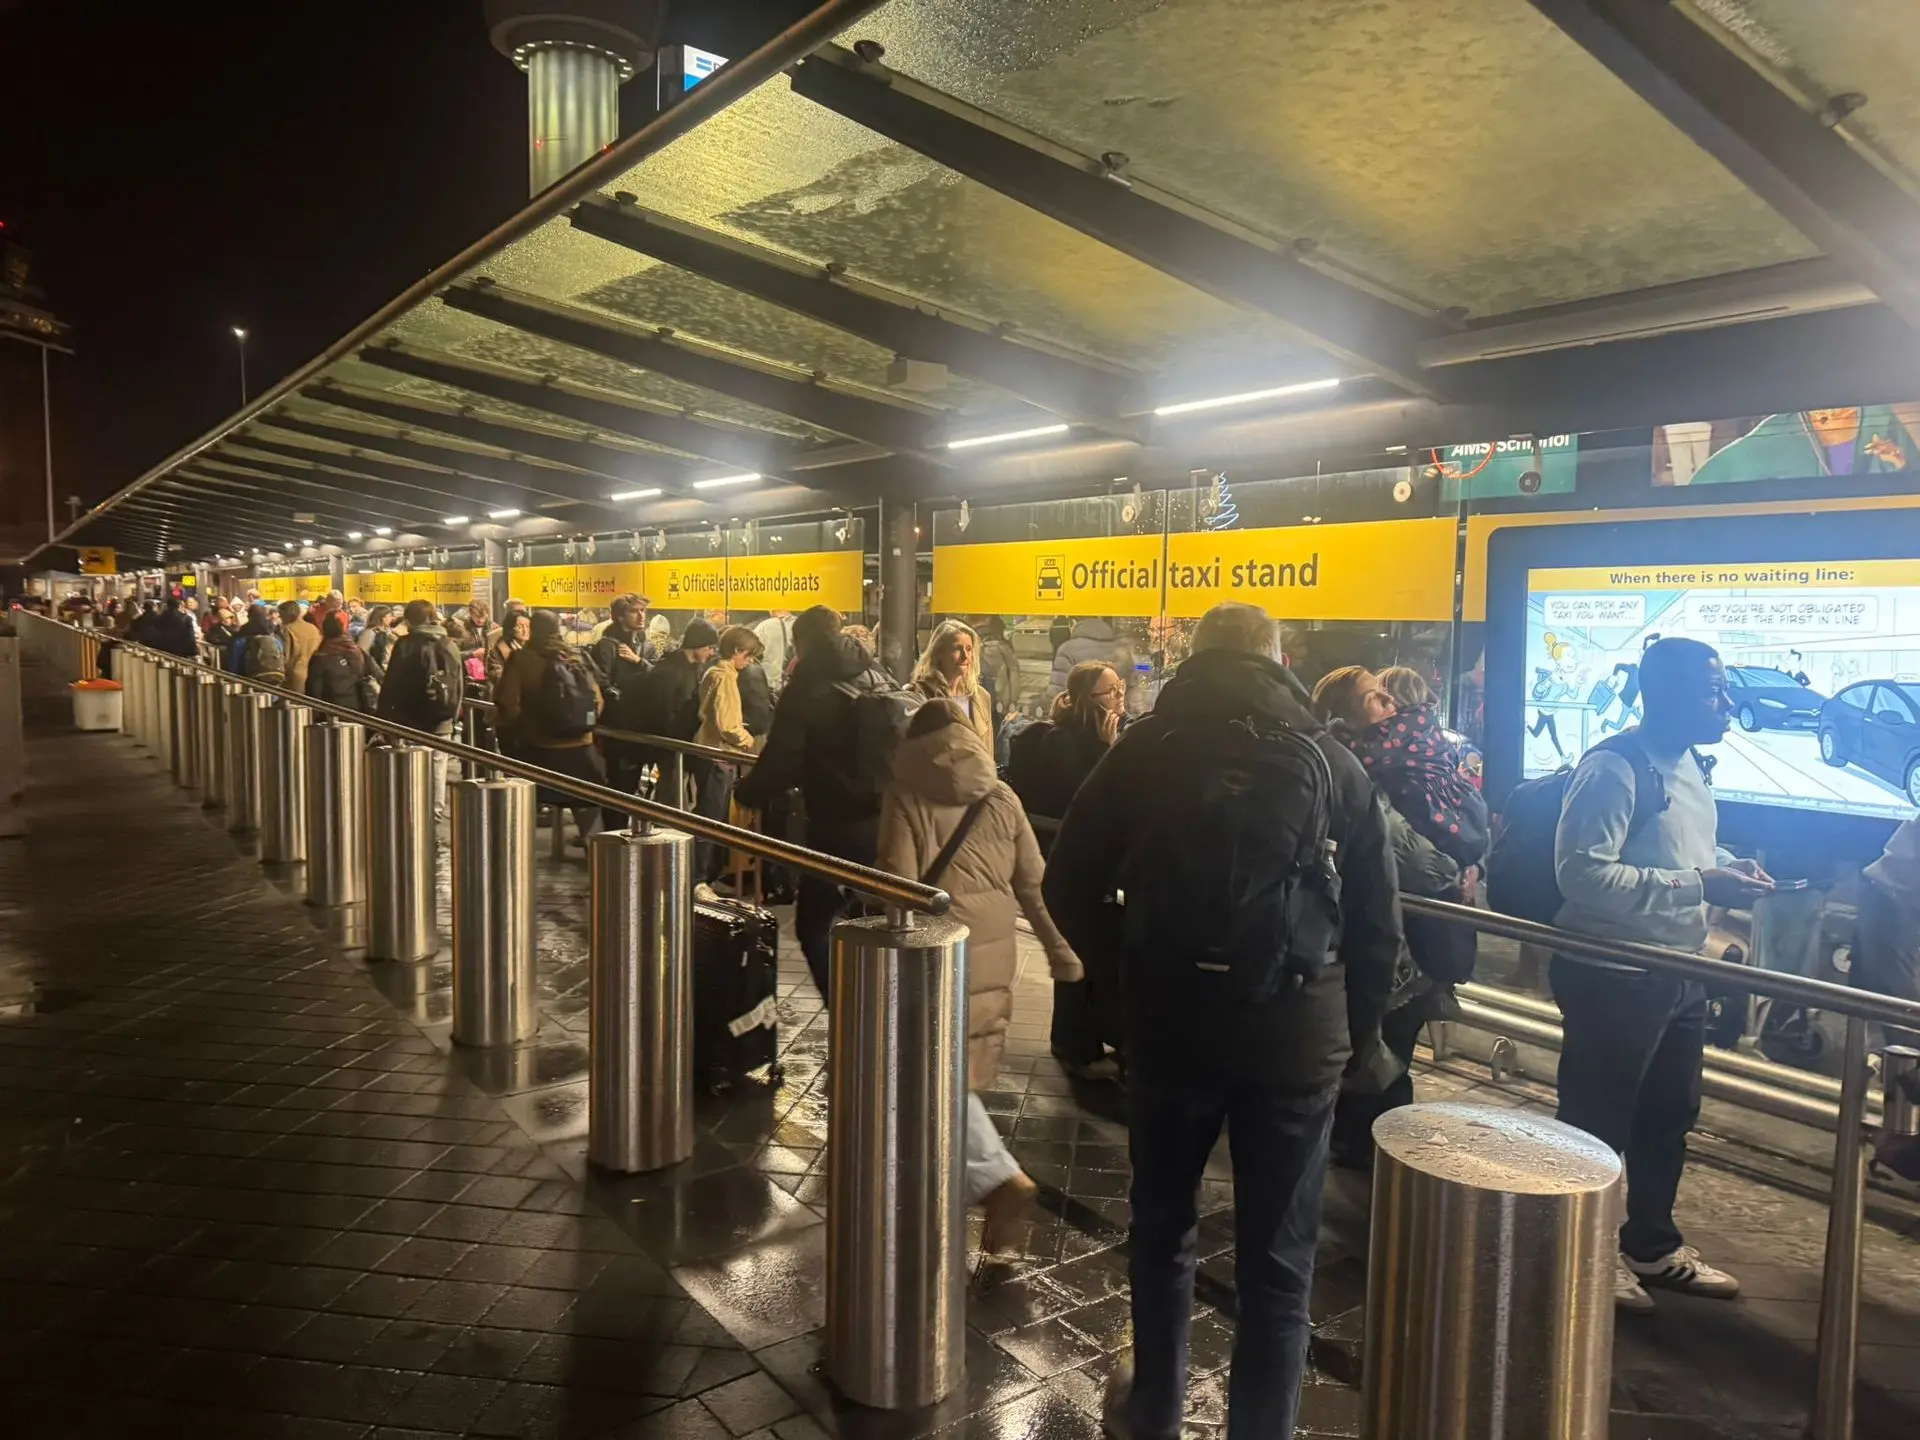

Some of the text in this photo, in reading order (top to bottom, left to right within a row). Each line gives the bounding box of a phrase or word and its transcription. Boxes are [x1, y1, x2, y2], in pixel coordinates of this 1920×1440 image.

[1496, 434, 1570, 453] Schihol
[1072, 553, 1319, 589] Official taxi stand
[1610, 568, 1855, 584] When there is no waiting line:
[550, 576, 615, 593] Official taxi stand
[683, 571, 820, 596] Officiële taxistandplaats
[1550, 600, 1639, 610] YOU CAN PICK ANY
[1699, 604, 1720, 613] AND
[1770, 604, 1793, 613] NOT
[1797, 604, 1866, 613] OBLIGATED
[1553, 611, 1572, 619] TAXI
[1576, 611, 1594, 619] YOU
[1702, 615, 1860, 624] TO TAKE THE FIRST IN LINE
